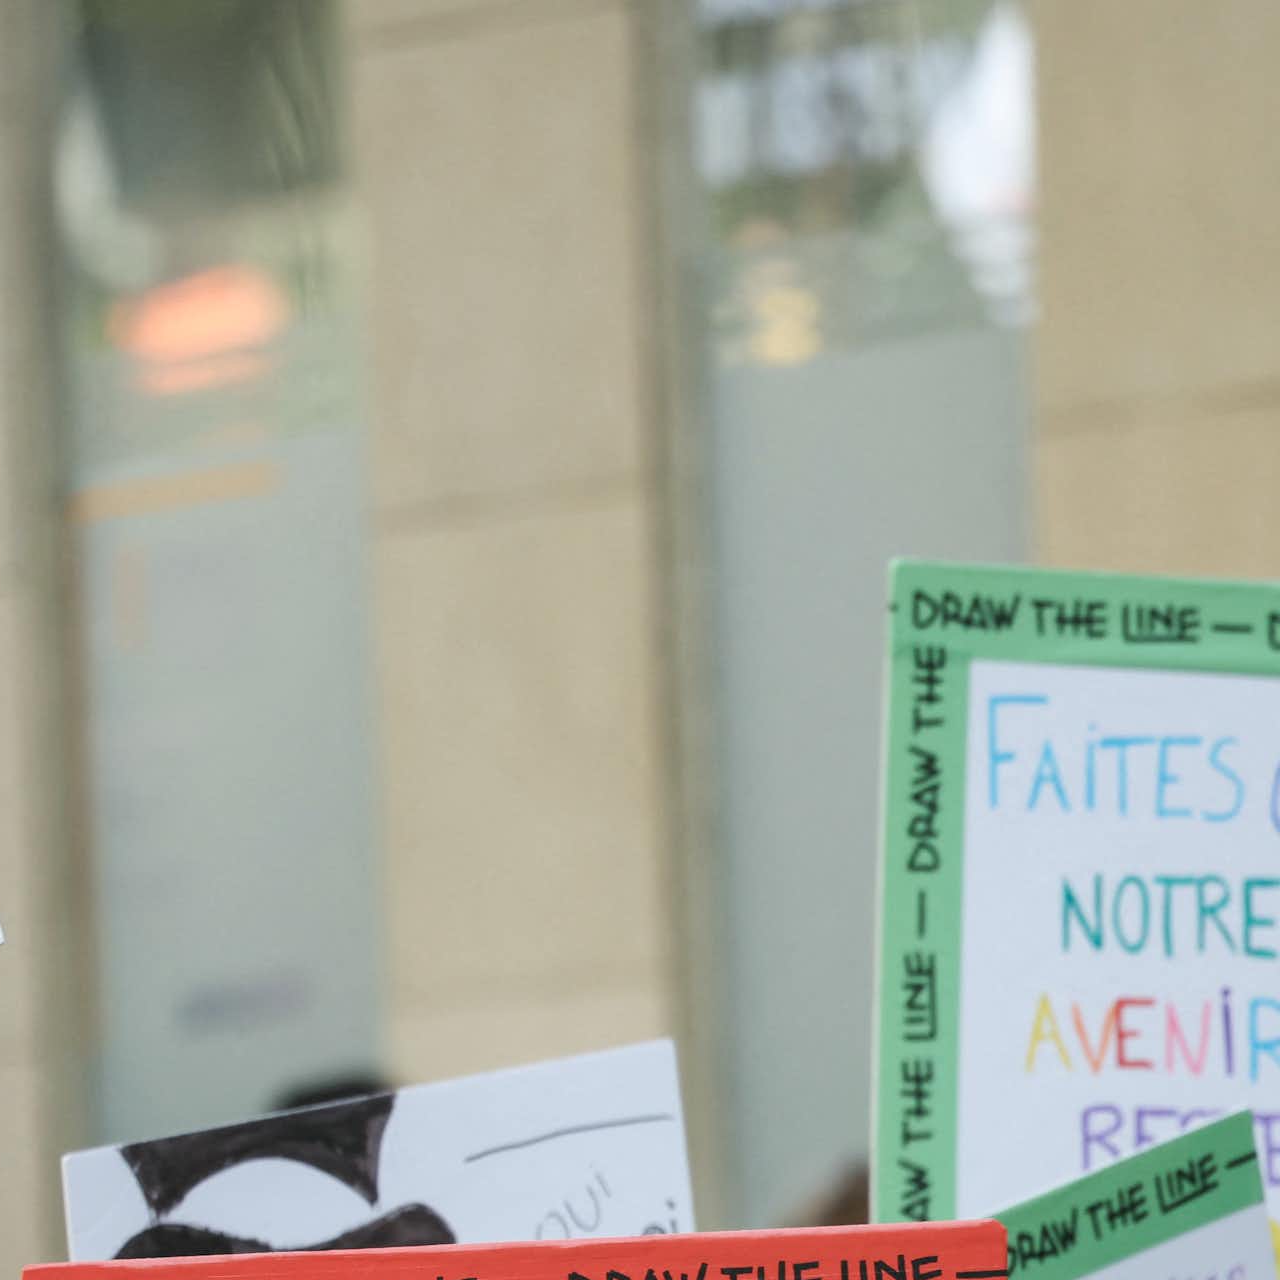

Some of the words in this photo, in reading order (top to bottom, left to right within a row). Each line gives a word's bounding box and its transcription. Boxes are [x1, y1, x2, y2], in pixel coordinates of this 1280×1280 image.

[911, 590, 1021, 632] DRAW
[1030, 599, 1107, 640] THE
[1122, 602, 1200, 644] LINE
[911, 646, 946, 735] THE
[906, 746, 940, 873] DRAW
[1062, 873, 1280, 960] NOTRE
[903, 952, 938, 1043] LINE
[900, 1059, 935, 1149] THE
[898, 1158, 930, 1221] AW
[1085, 1183, 1149, 1240] THE
[1154, 1153, 1219, 1215] LINE
